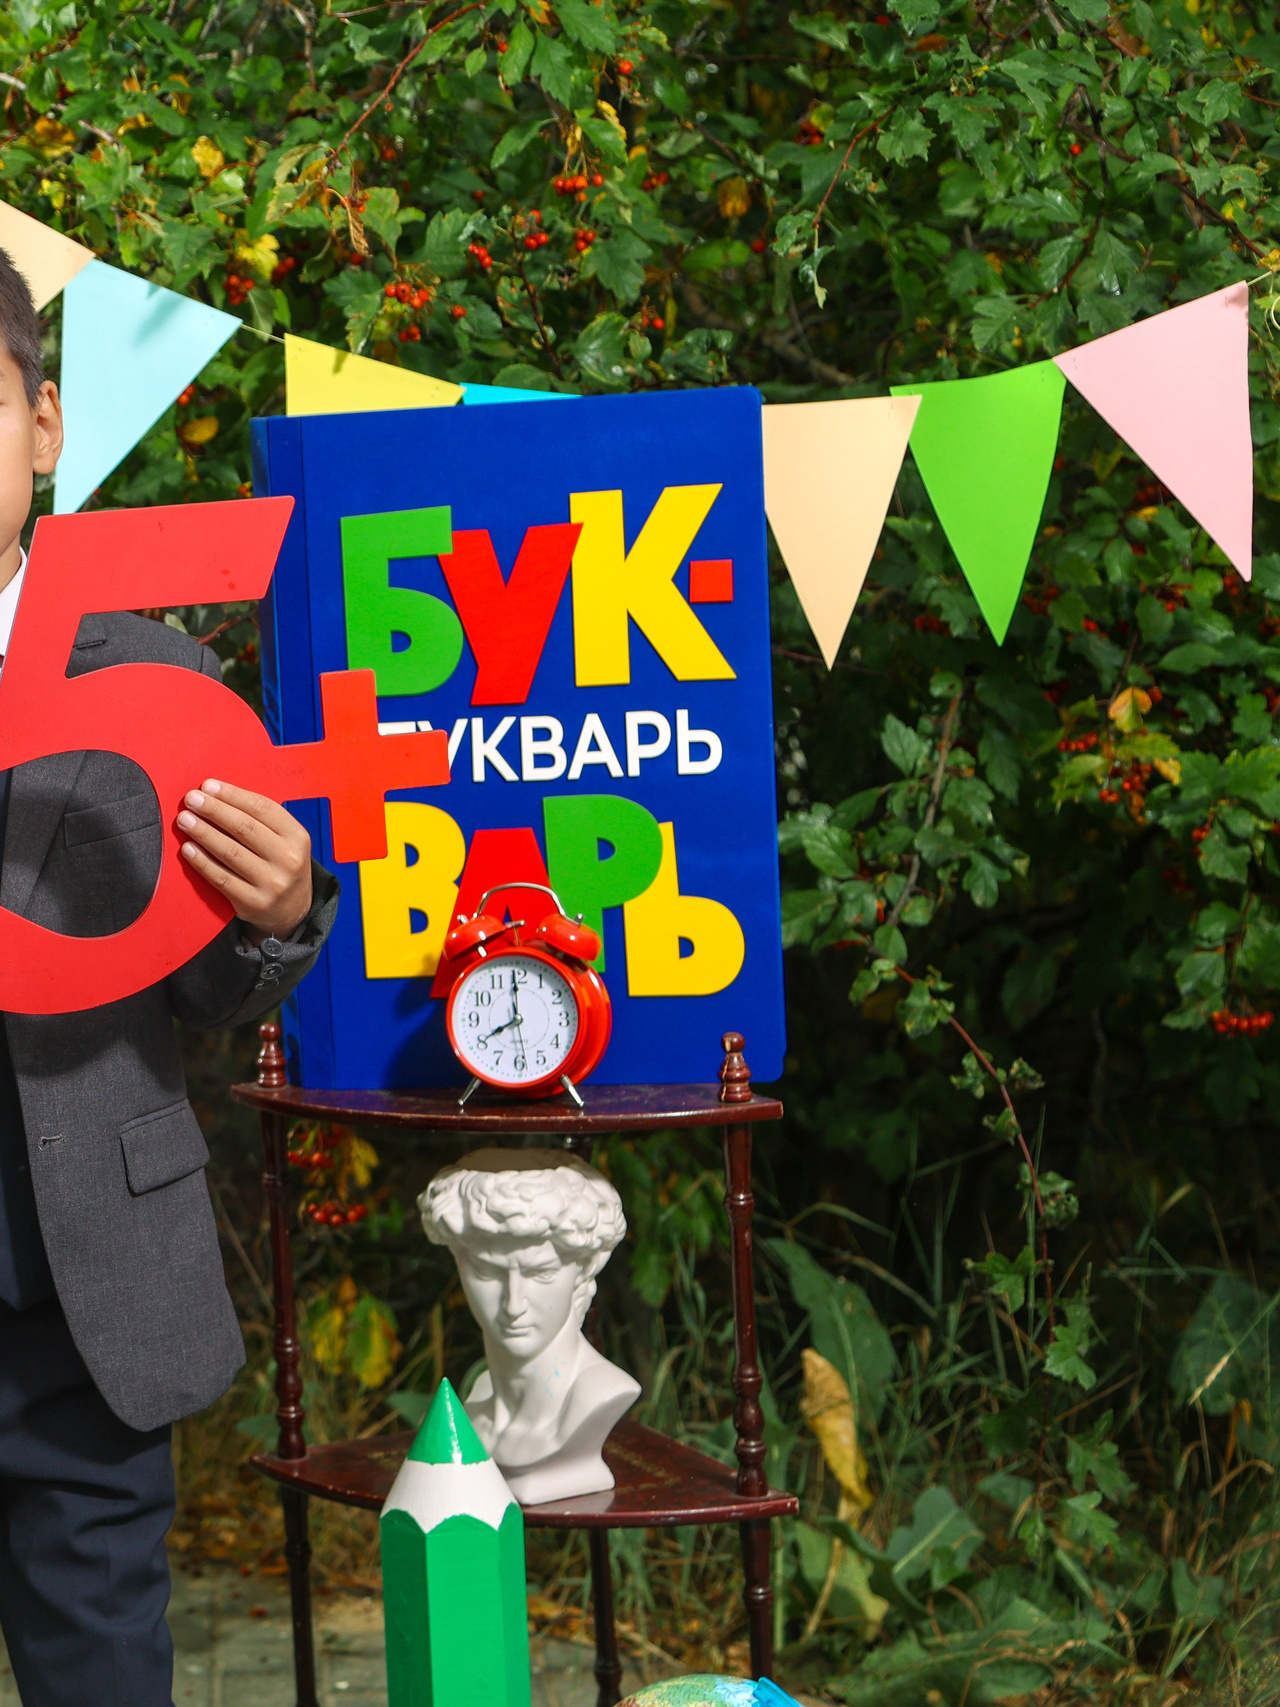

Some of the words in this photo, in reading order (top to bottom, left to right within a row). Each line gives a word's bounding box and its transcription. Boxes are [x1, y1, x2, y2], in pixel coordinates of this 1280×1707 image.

[378, 709, 723, 783] УКВАРЬ
[359, 794, 745, 998] ВАРЬ
[490, 974, 504, 989] 11
[538, 973, 544, 989] 1
[474, 991, 491, 1007] 10
[551, 989, 563, 1005] 2
[468, 1011, 479, 1028] 9
[559, 1011, 570, 1028] 3
[477, 1034, 488, 1050] 8
[550, 1033, 561, 1049] 4
[493, 1050, 504, 1066] 7
[513, 1054, 526, 1071] 6
[536, 1050, 547, 1065] 5
